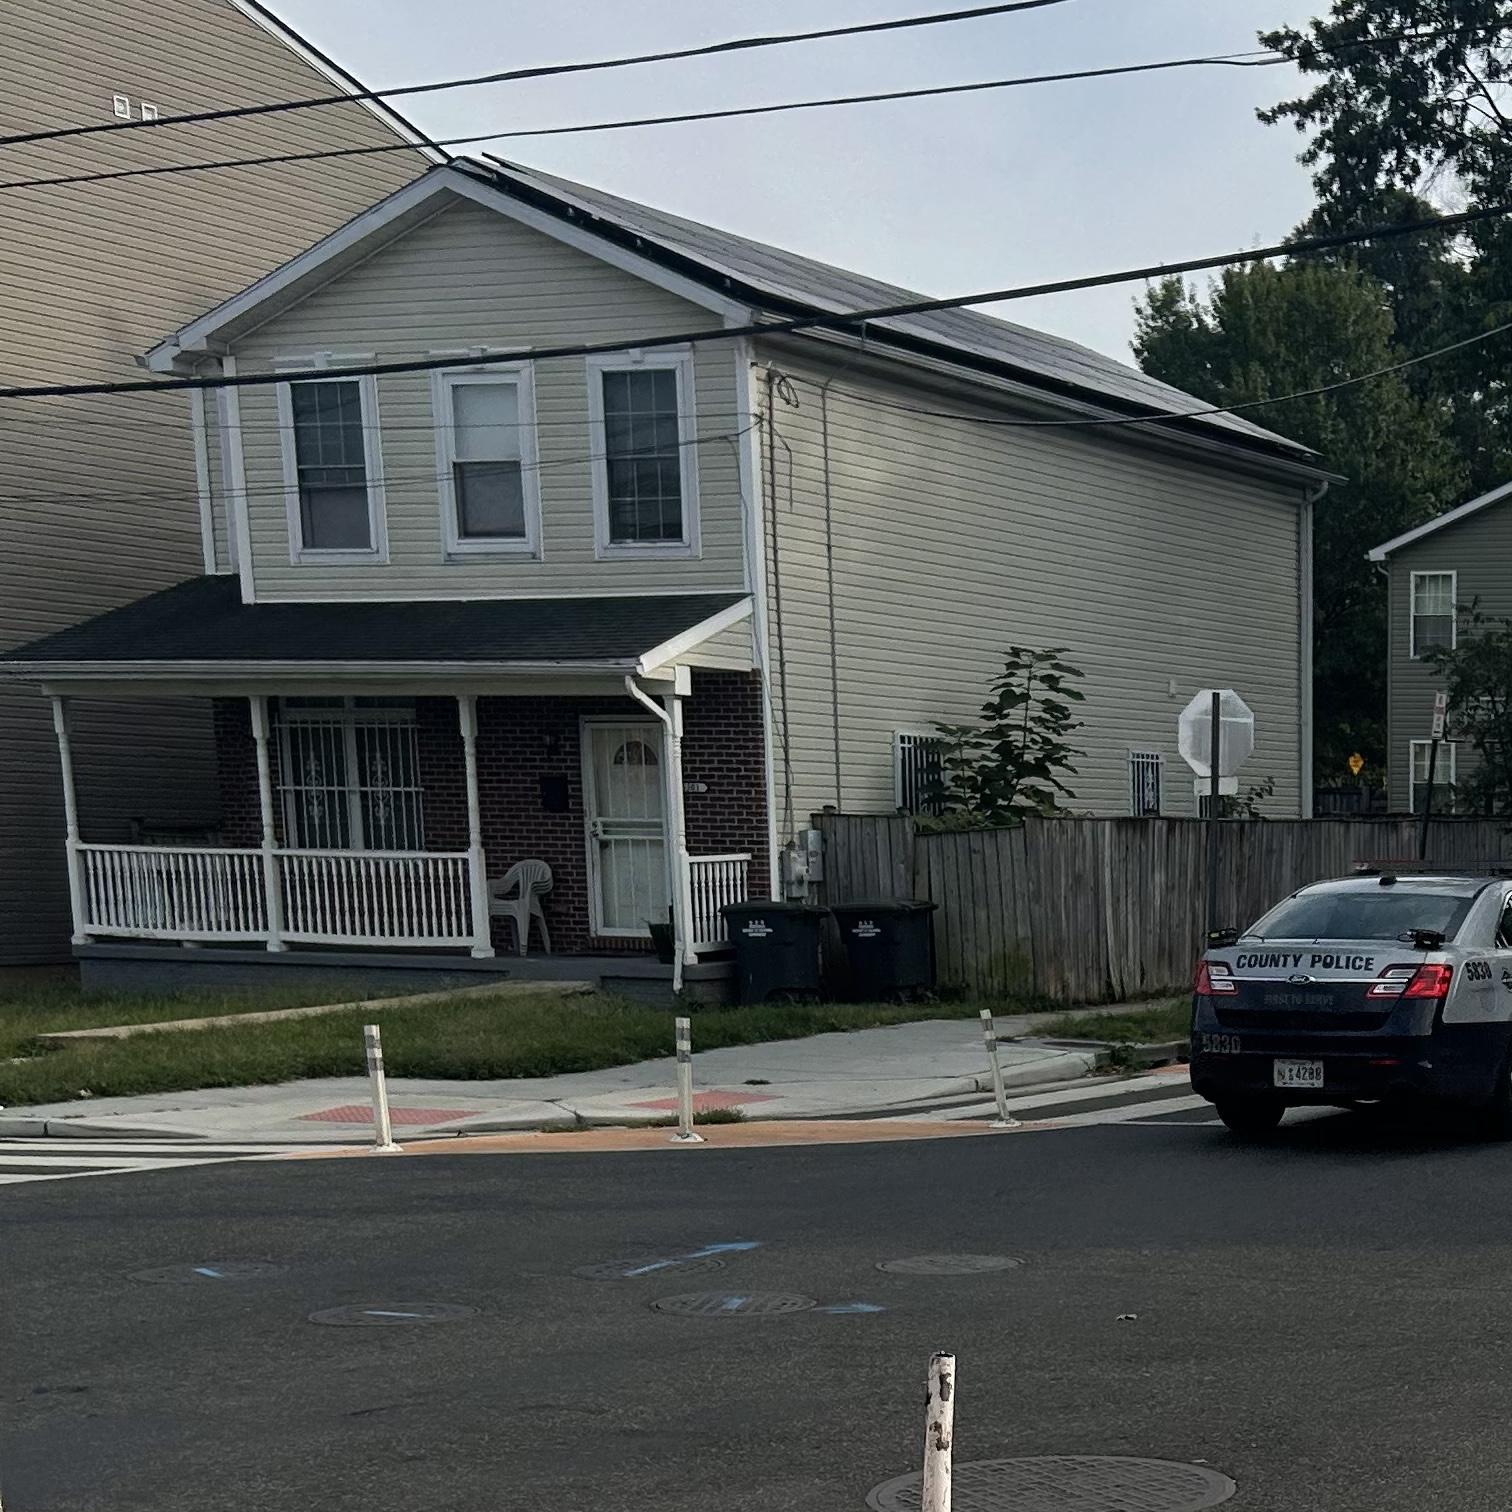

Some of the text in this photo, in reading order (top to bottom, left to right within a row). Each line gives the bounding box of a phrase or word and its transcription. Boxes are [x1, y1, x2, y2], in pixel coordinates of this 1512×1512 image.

[1236, 955, 1374, 971] COUNTY POLICE
[1466, 962, 1493, 981] 5830
[1201, 1034, 1241, 1054] 5830
